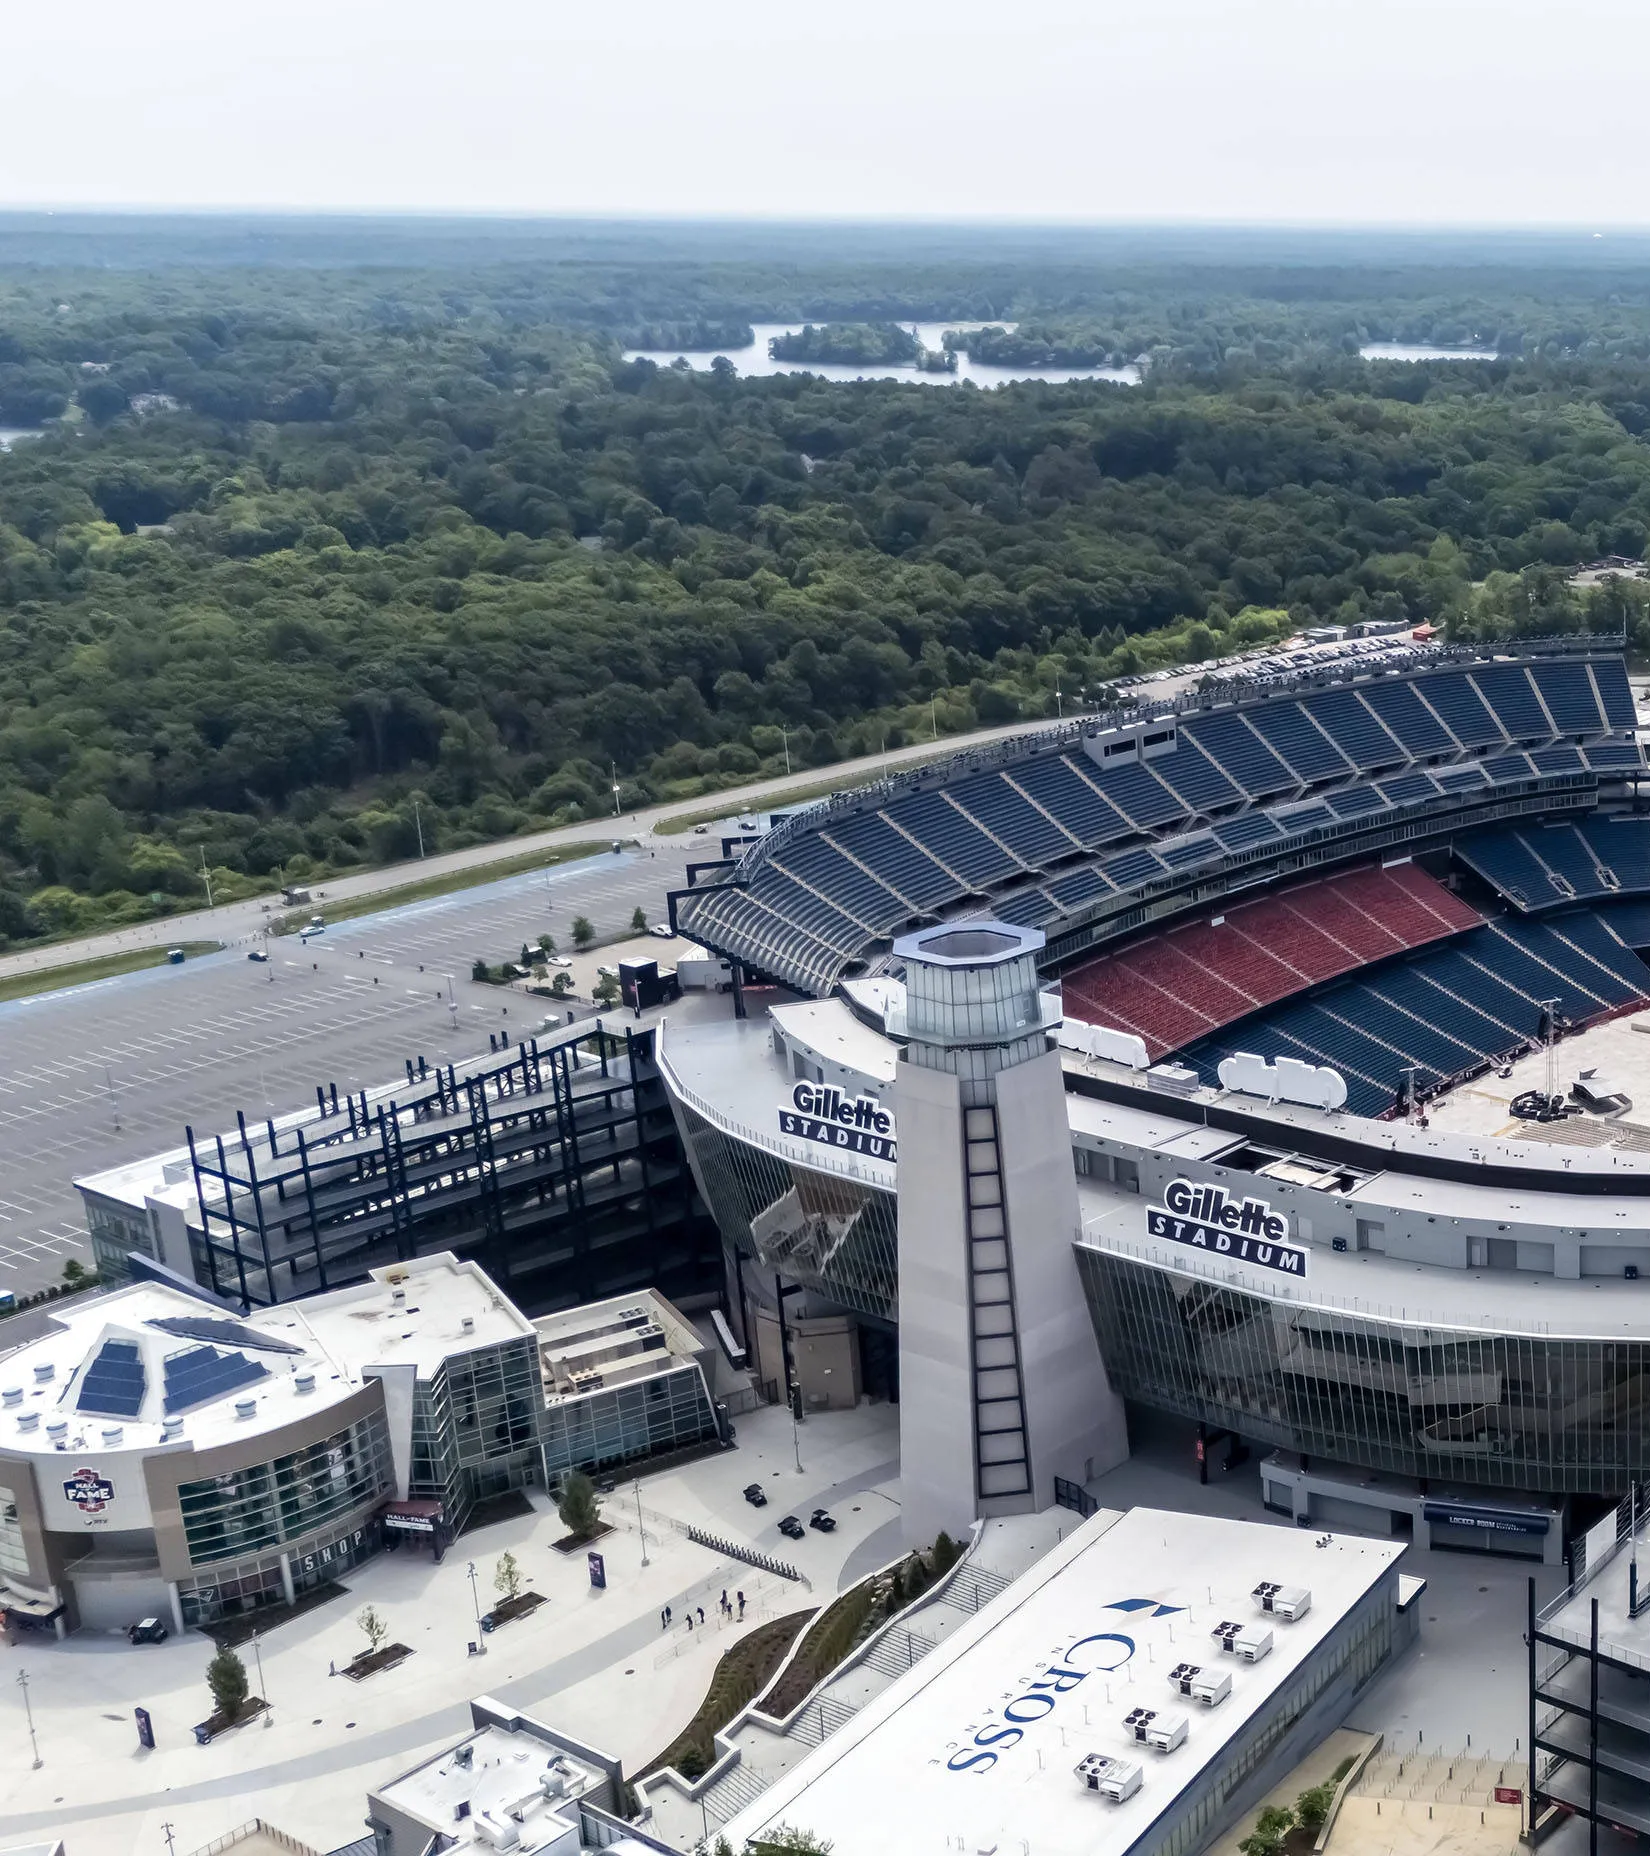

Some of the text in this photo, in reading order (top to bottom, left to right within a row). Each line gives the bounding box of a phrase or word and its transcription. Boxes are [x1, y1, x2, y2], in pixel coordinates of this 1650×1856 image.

[793, 1083, 891, 1135] Gillette
[1166, 1182, 1285, 1241] Gillette
[1154, 1216, 1300, 1271] STADIUM
[67, 1488, 110, 1500] FAME
[304, 1530, 362, 1571] SHOP
[928, 1635, 1076, 1766] INSURANCE
[947, 1633, 1136, 1775] CROSS
